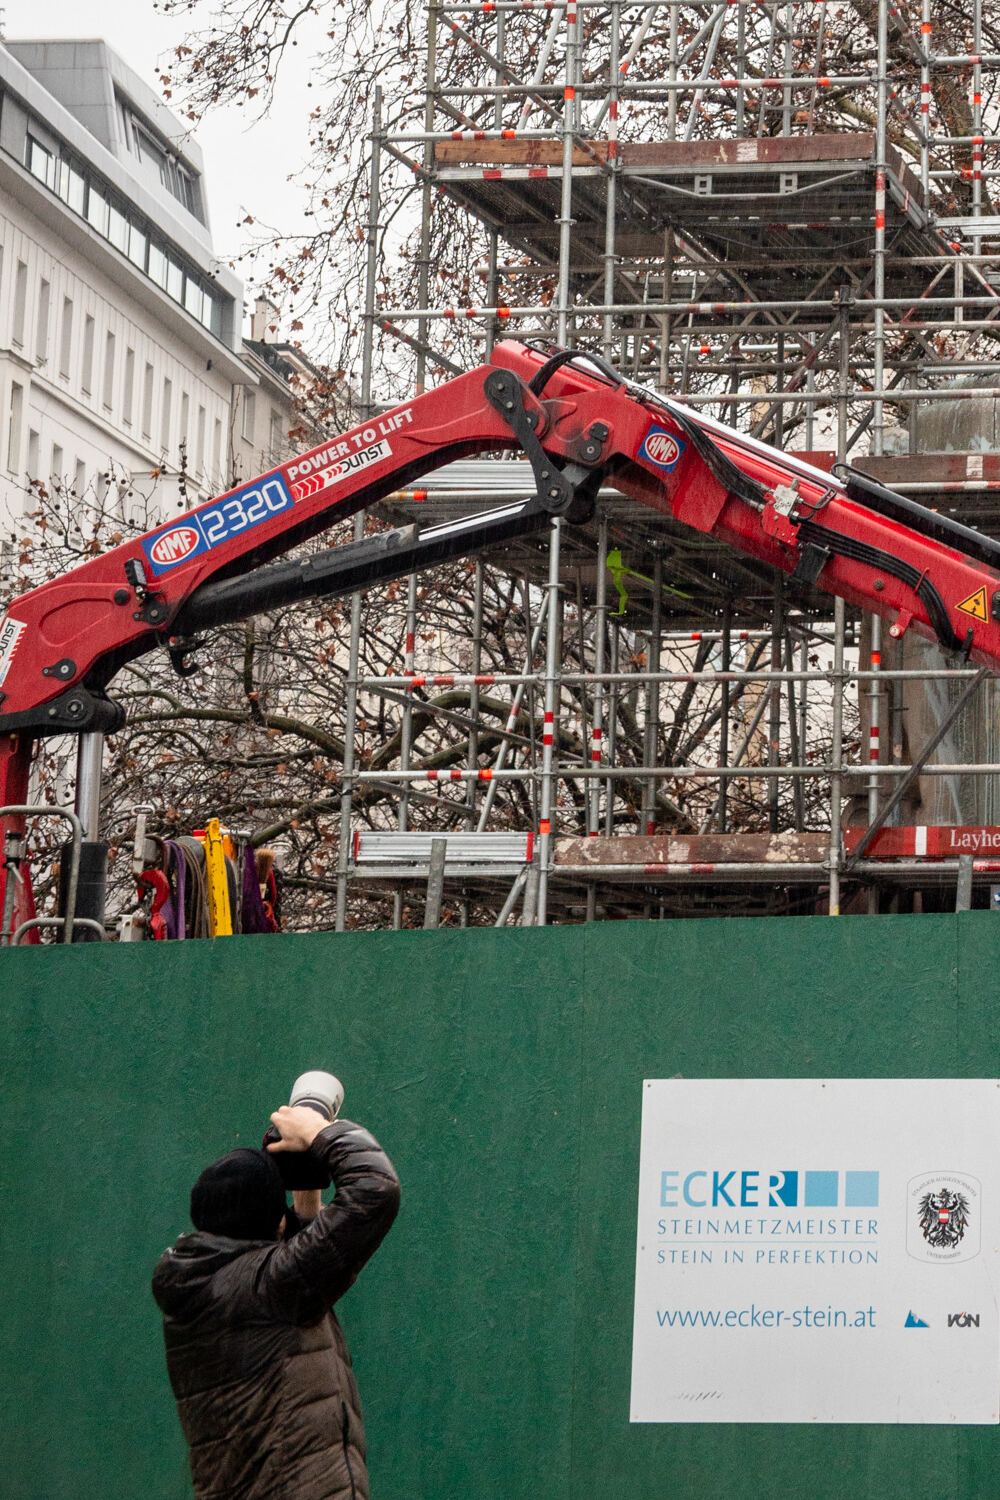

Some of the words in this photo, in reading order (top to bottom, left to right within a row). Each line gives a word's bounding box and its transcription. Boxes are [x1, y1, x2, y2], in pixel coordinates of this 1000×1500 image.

[286, 441, 351, 482] POWER
[350, 428, 377, 449] TO
[378, 407, 414, 436] LIFT
[339, 442, 384, 474] DUNST
[648, 435, 677, 462] HMF
[155, 531, 192, 560] HMF
[201, 480, 288, 543] 2320
[660, 1170, 788, 1207] ECKER
[657, 1219, 879, 1235] STEINMETZMEISTER
[657, 1250, 713, 1264] STEIN
[724, 1250, 744, 1263] IN
[755, 1250, 879, 1264] PERFEKTION
[656, 1304, 877, 1328] www.ecker-stein.at
